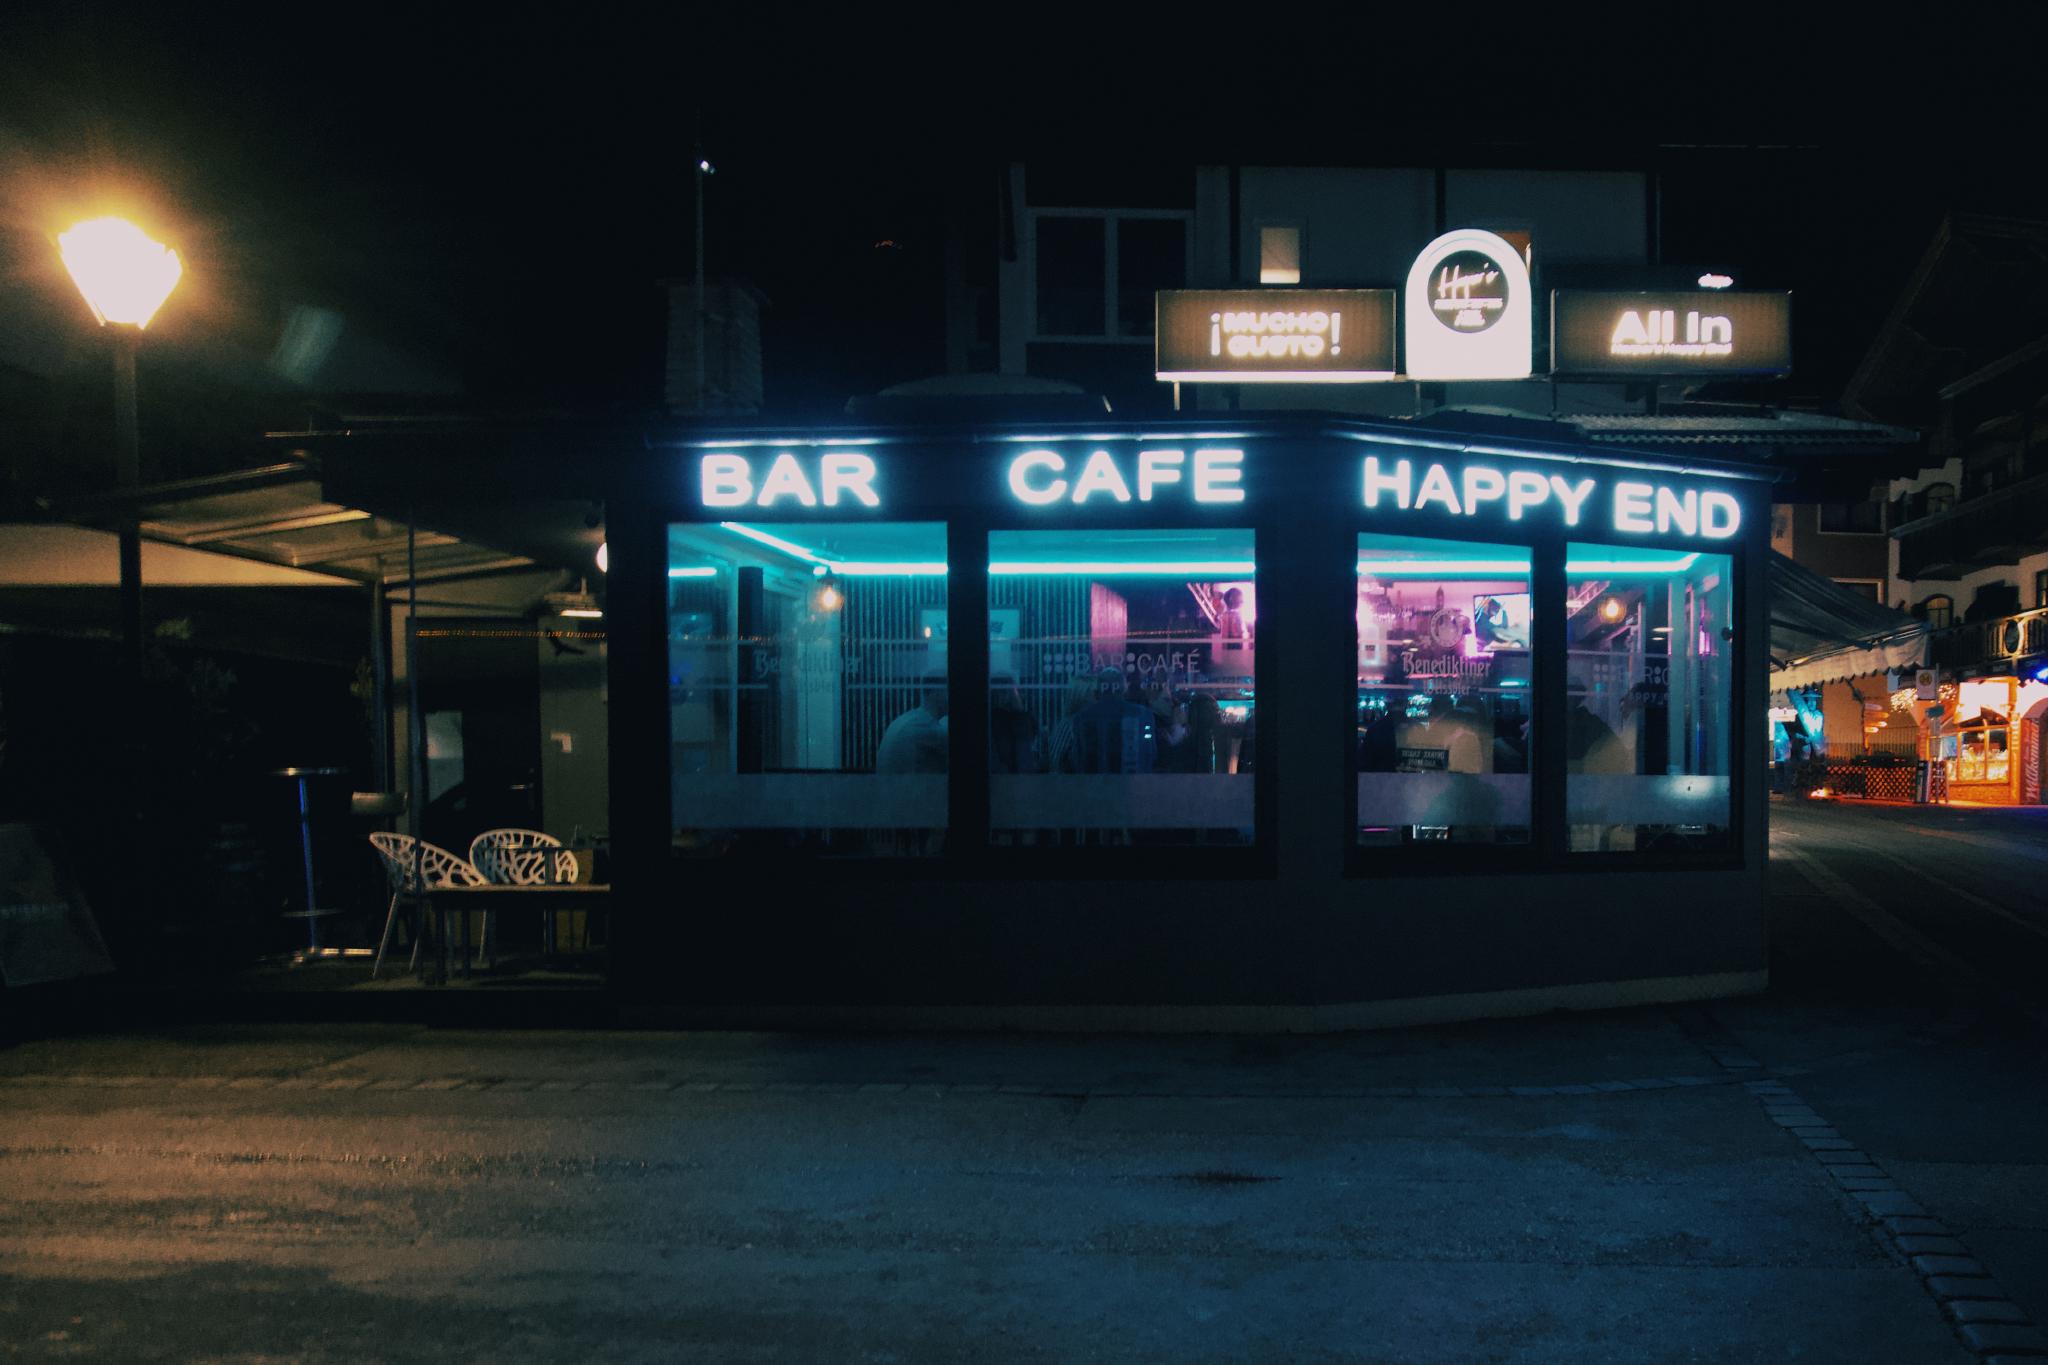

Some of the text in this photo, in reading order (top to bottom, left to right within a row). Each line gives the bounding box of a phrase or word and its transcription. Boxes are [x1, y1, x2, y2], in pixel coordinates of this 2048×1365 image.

[1612, 310, 1733, 344] All In
[702, 449, 1741, 538] BAR CAFE HAPPY END
[1400, 651, 1491, 678] Benediktiner
